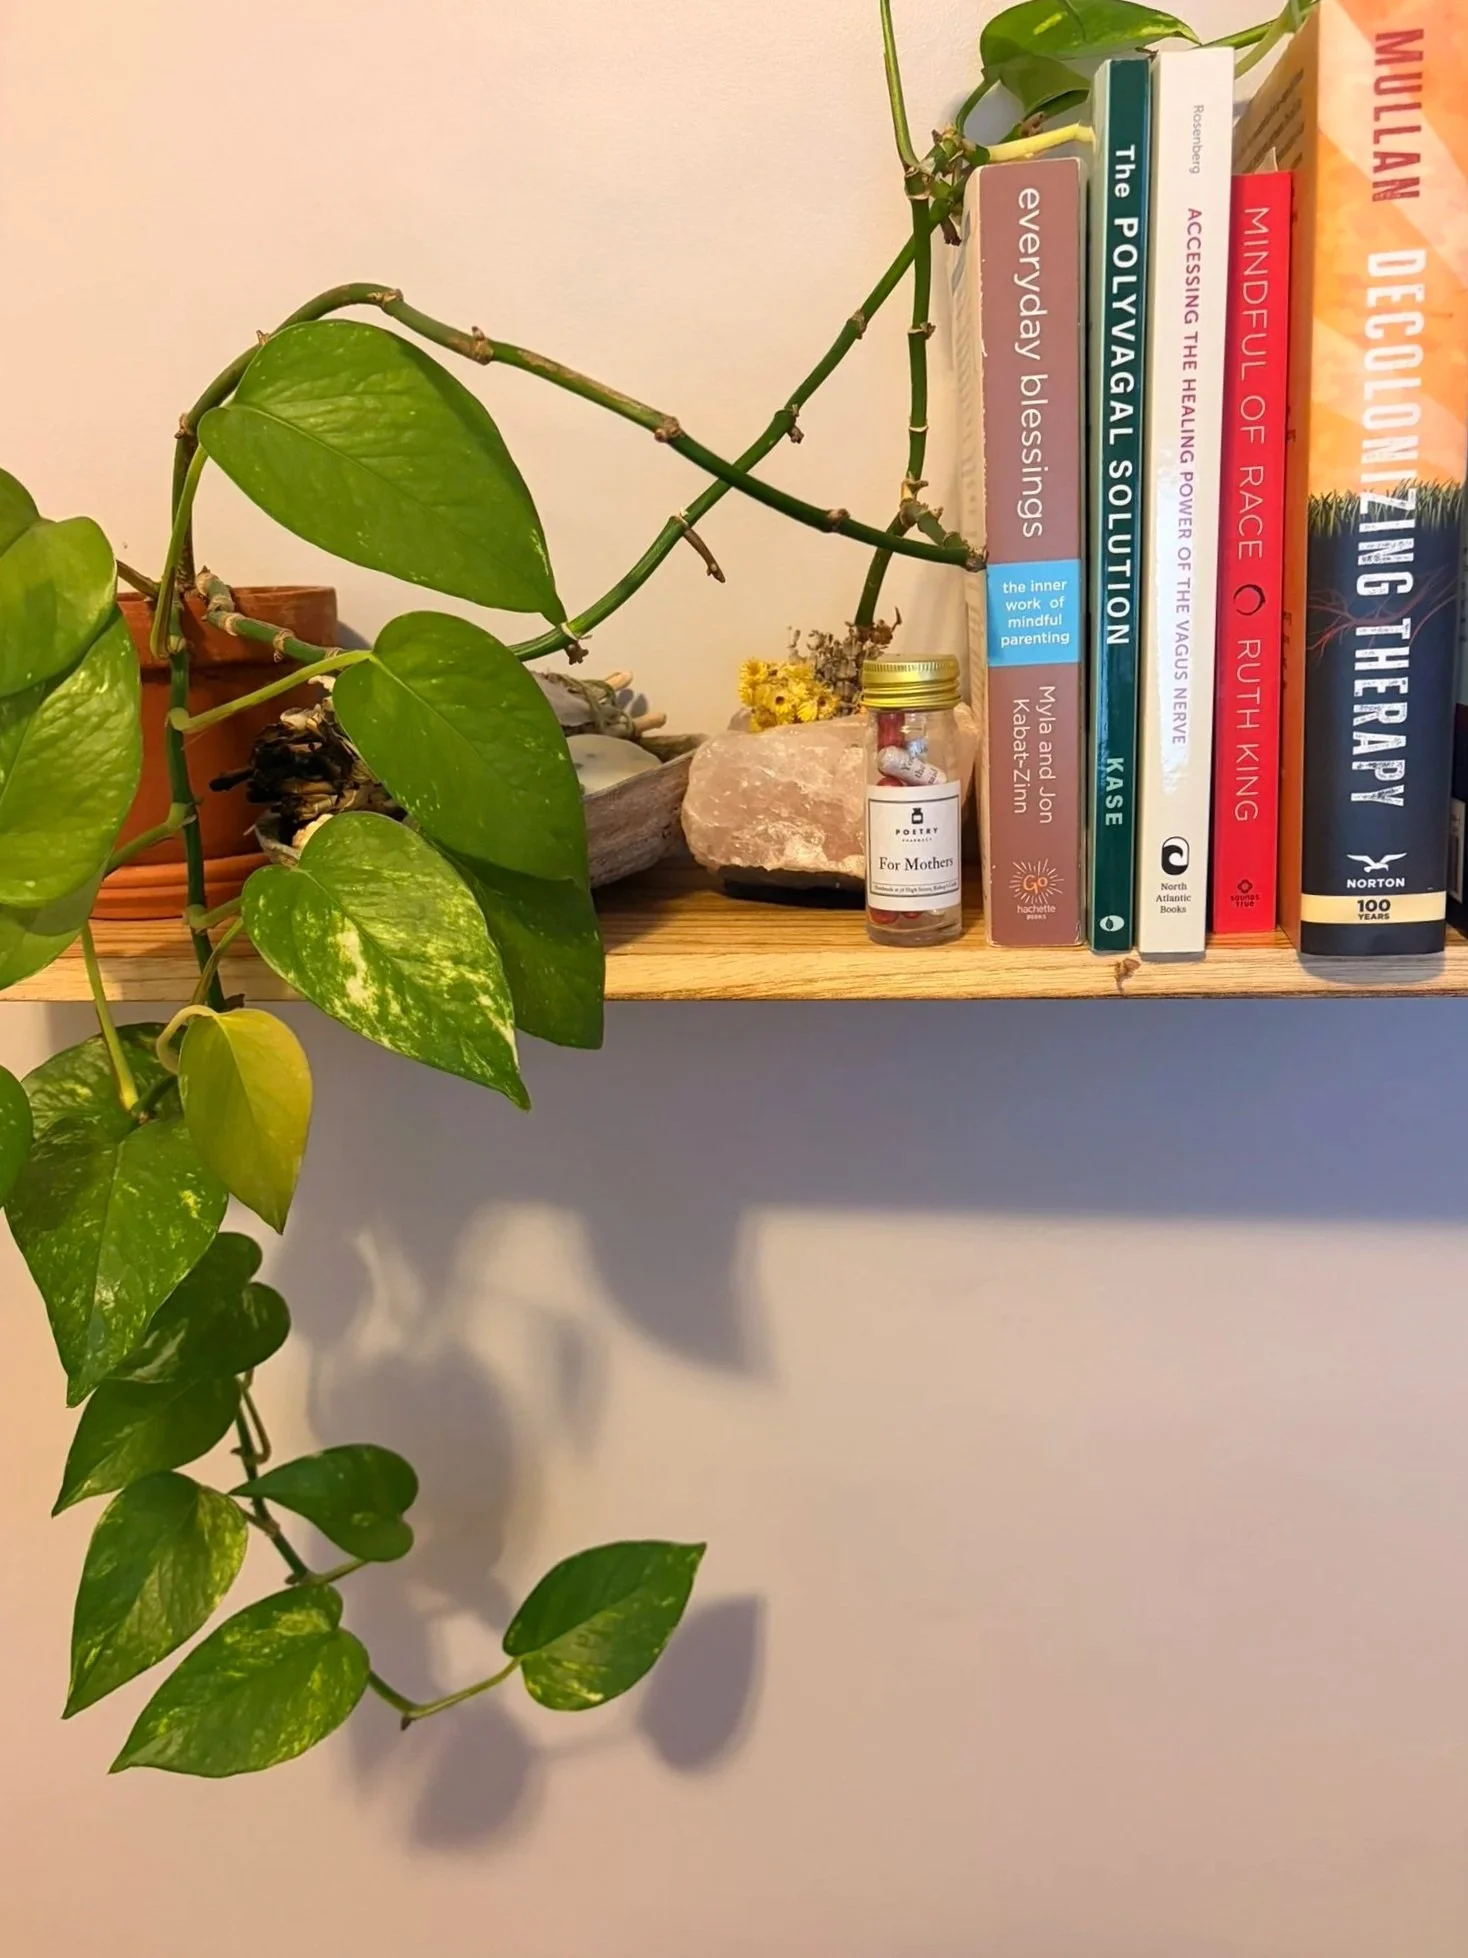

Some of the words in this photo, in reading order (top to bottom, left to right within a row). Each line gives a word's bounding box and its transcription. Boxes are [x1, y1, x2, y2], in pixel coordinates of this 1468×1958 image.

[1189, 104, 1204, 174] Rosenberg
[1372, 28, 1424, 202] MULLAN
[1114, 144, 1136, 198] The
[1013, 187, 1048, 361] everyday
[1184, 207, 1202, 325] ACCESSING
[1241, 206, 1270, 382] MINDFUL
[1109, 216, 1139, 446] POLYVAGAL
[1182, 331, 1199, 371] THE
[1179, 378, 1197, 464] HEALING
[1239, 394, 1266, 446] OF
[1356, 248, 1427, 596] DECOLONIZING
[1017, 374, 1049, 538] blessings
[1177, 471, 1194, 540] POWER
[1237, 465, 1265, 561] RACE
[1106, 459, 1133, 645] SOLUTION
[1176, 546, 1192, 572] OF
[1002, 580, 1026, 594] the
[1030, 579, 1068, 592] inner
[1005, 597, 1041, 612] work
[1049, 595, 1065, 609] of
[1175, 576, 1191, 614] THE
[1000, 631, 1070, 649] parenting
[1007, 613, 1062, 629] mindful
[1173, 619, 1190, 681] VAGUS
[1036, 685, 1056, 734] Myla
[1235, 638, 1261, 729] RUTH
[1172, 687, 1188, 745] NERVE
[1350, 617, 1412, 807] THERAPY
[1012, 698, 1031, 814] Kabat-Zinn
[1038, 741, 1056, 779] and
[1039, 786, 1056, 824] Jon
[1105, 757, 1124, 826] KASE
[1234, 743, 1260, 822] KING
[895, 827, 939, 836] POETRY
[878, 856, 900, 871] For
[903, 856, 954, 871] Mothers
[1023, 874, 1049, 895] Go
[1160, 882, 1188, 891] North
[1346, 877, 1406, 889] NORTON
[1017, 904, 1057, 914] hachette
[1156, 894, 1192, 903] Atlantic
[1159, 905, 1187, 914] Books
[1357, 898, 1391, 913] 100
[1358, 912, 1390, 921] YEARS
